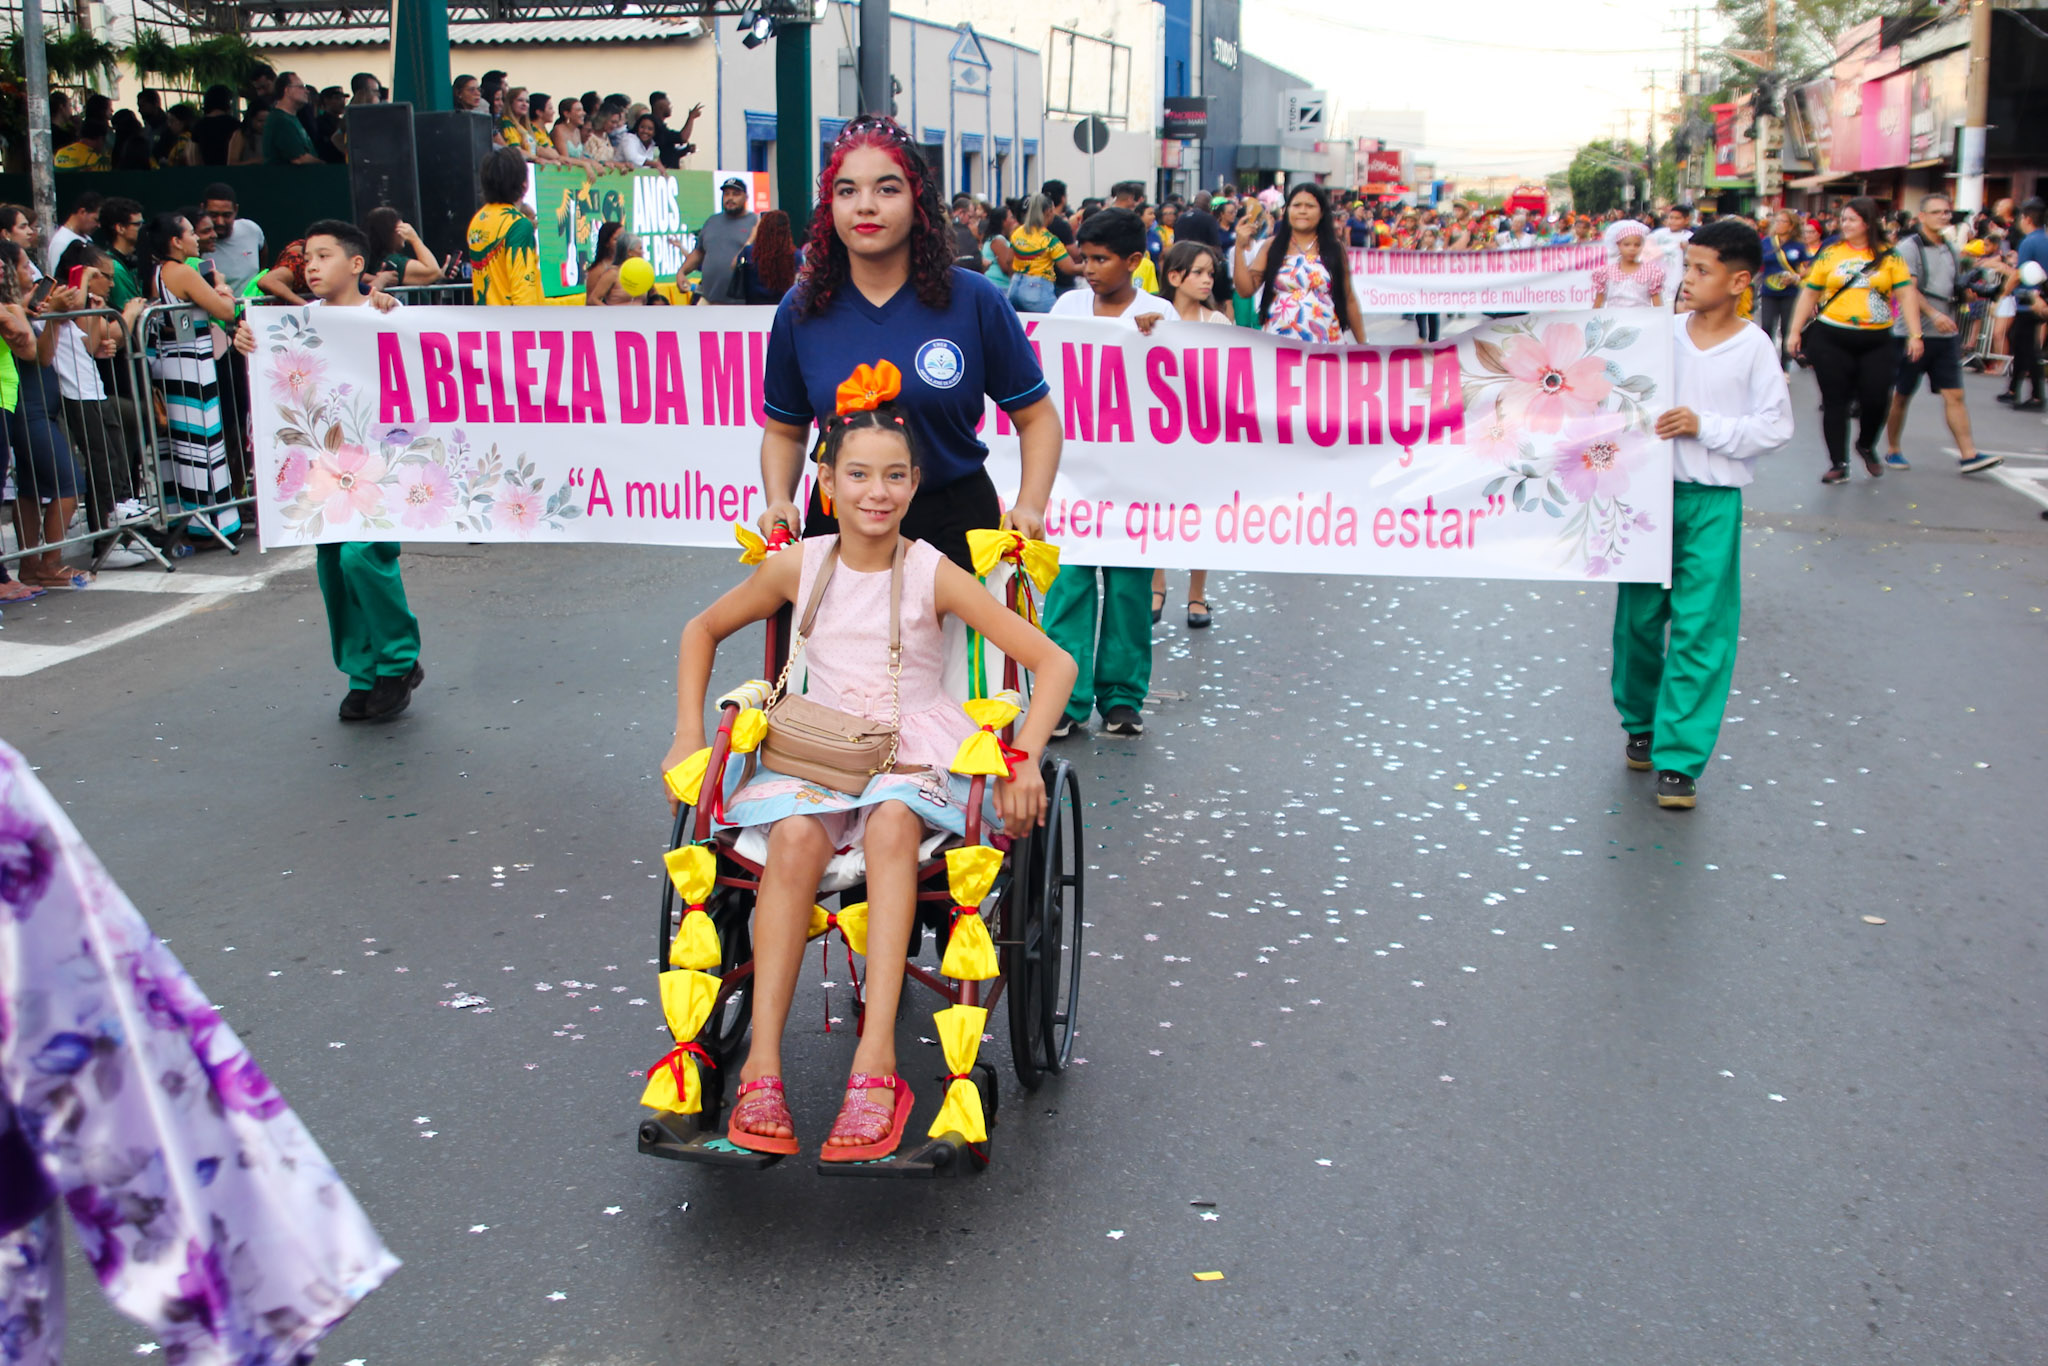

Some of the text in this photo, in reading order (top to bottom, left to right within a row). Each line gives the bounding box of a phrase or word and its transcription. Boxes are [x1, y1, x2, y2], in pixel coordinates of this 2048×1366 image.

[1289, 96, 1297, 132] STUDIO
[1367, 251, 1385, 275] DA
[1389, 251, 1446, 275] MULHER
[1487, 251, 1505, 273] NA
[1509, 249, 1536, 273] SUA
[1420, 288, 1477, 308] herança
[1481, 287, 1498, 304] de
[1502, 286, 1566, 304] mulheres
[377, 332, 415, 424] A
[420, 331, 607, 424] BELEZA
[615, 331, 689, 425] DA
[1062, 342, 1135, 443] NA
[1146, 345, 1263, 445] SUA
[1276, 344, 1466, 468] FORÇA
[626, 470, 759, 522] mulher
[1046, 499, 1114, 539] uer
[1125, 501, 1201, 554] que
[1215, 490, 1358, 547] decida
